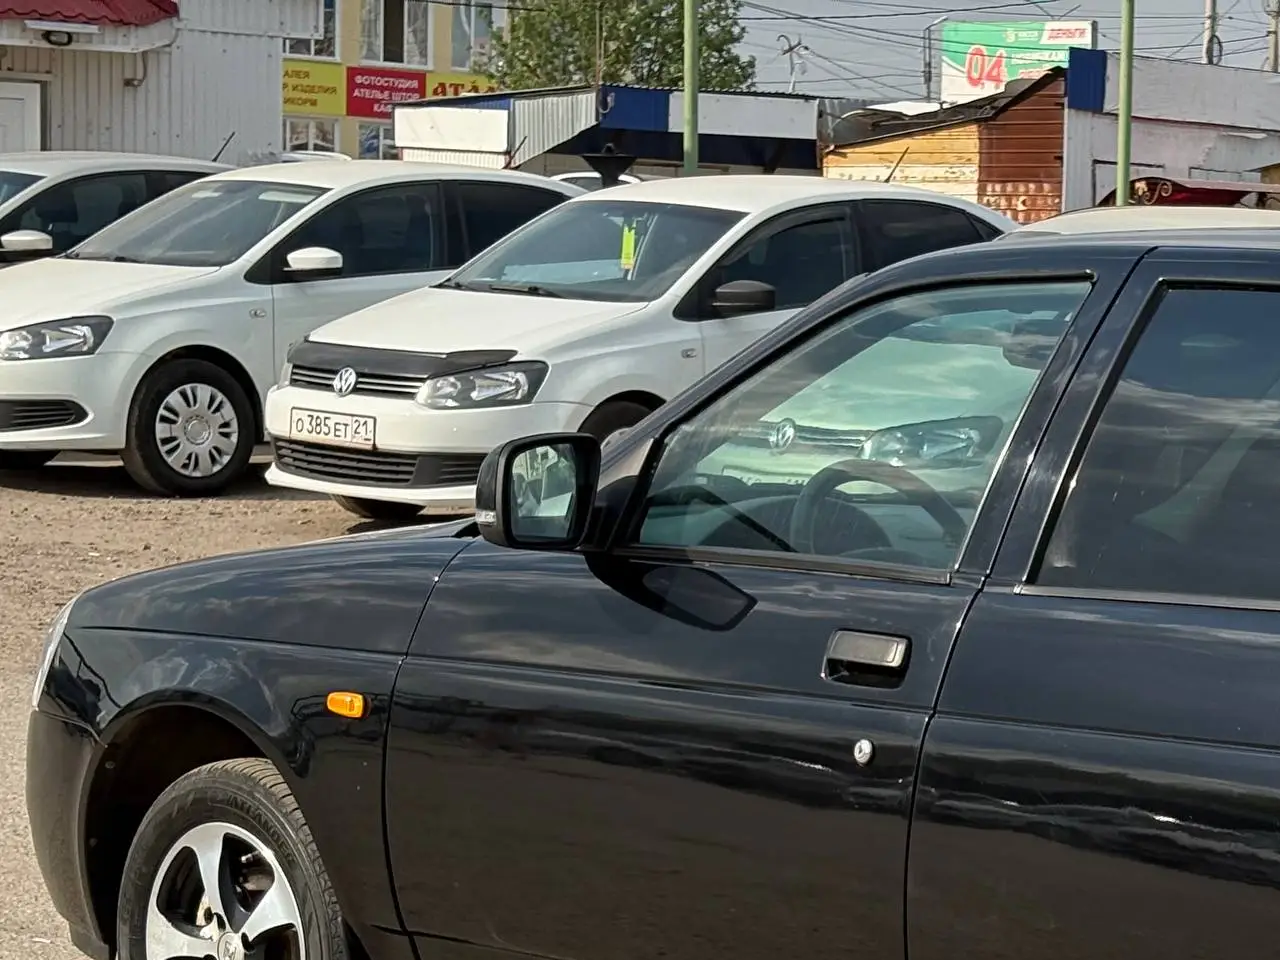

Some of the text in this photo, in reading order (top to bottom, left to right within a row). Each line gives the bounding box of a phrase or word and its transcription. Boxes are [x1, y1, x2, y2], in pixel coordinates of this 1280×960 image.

[353, 74, 420, 89] ФОТОСТУДИЯ
[291, 84, 338, 96] ИЗДЕЛИЯ
[352, 88, 391, 100] АТЕЛЬЕ
